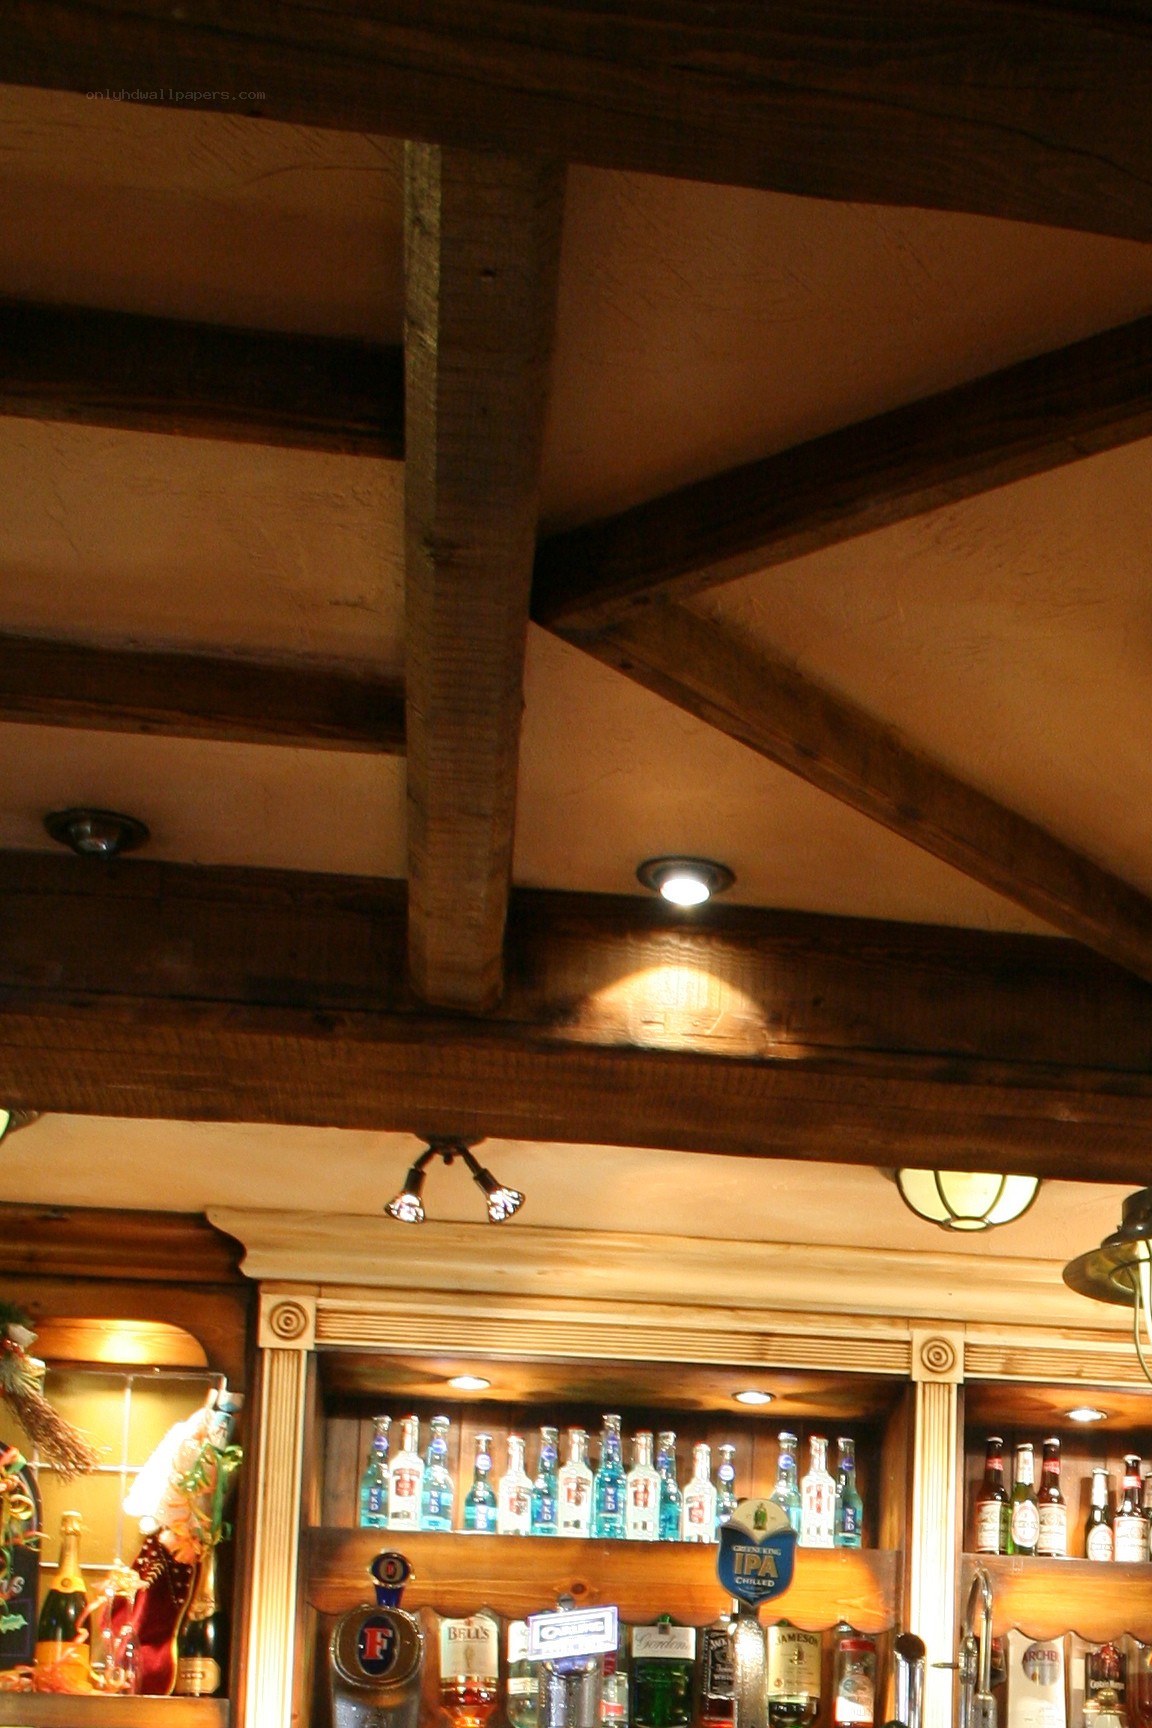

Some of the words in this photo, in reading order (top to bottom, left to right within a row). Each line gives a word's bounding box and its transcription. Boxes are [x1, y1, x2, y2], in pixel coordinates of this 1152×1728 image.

[733, 1552, 779, 1579] IPA
[734, 1576, 775, 1588] CHILLED
[448, 1625, 490, 1643] BELL'S
[777, 1630, 819, 1645] JAMESON
[362, 1626, 393, 1661] F
